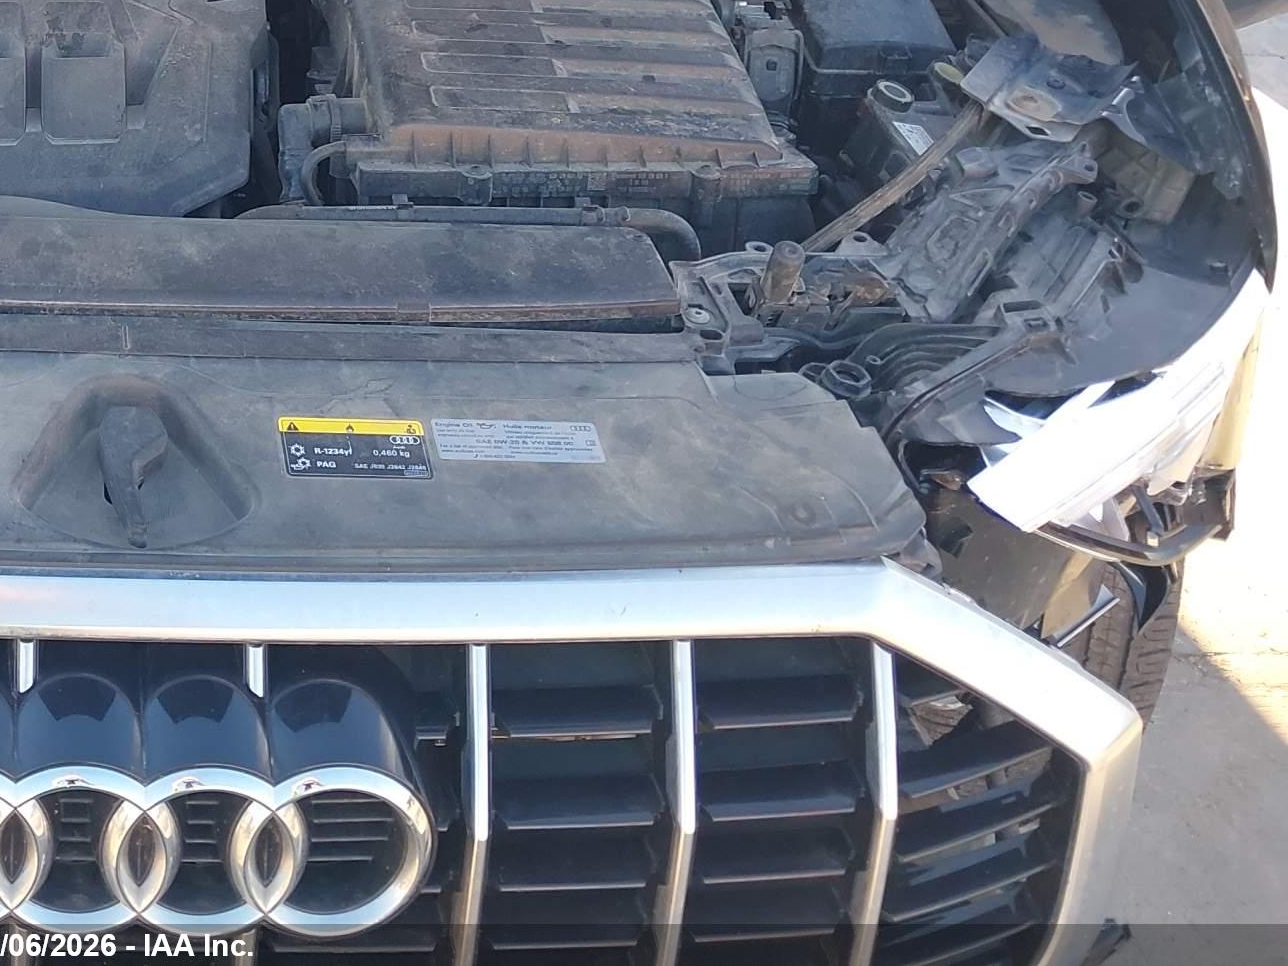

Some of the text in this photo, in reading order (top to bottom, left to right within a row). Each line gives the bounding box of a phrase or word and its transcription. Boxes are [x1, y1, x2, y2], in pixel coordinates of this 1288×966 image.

[314, 447, 353, 457] R-1234yf
[399, 449, 410, 459] kg
[316, 460, 337, 468] PAG
